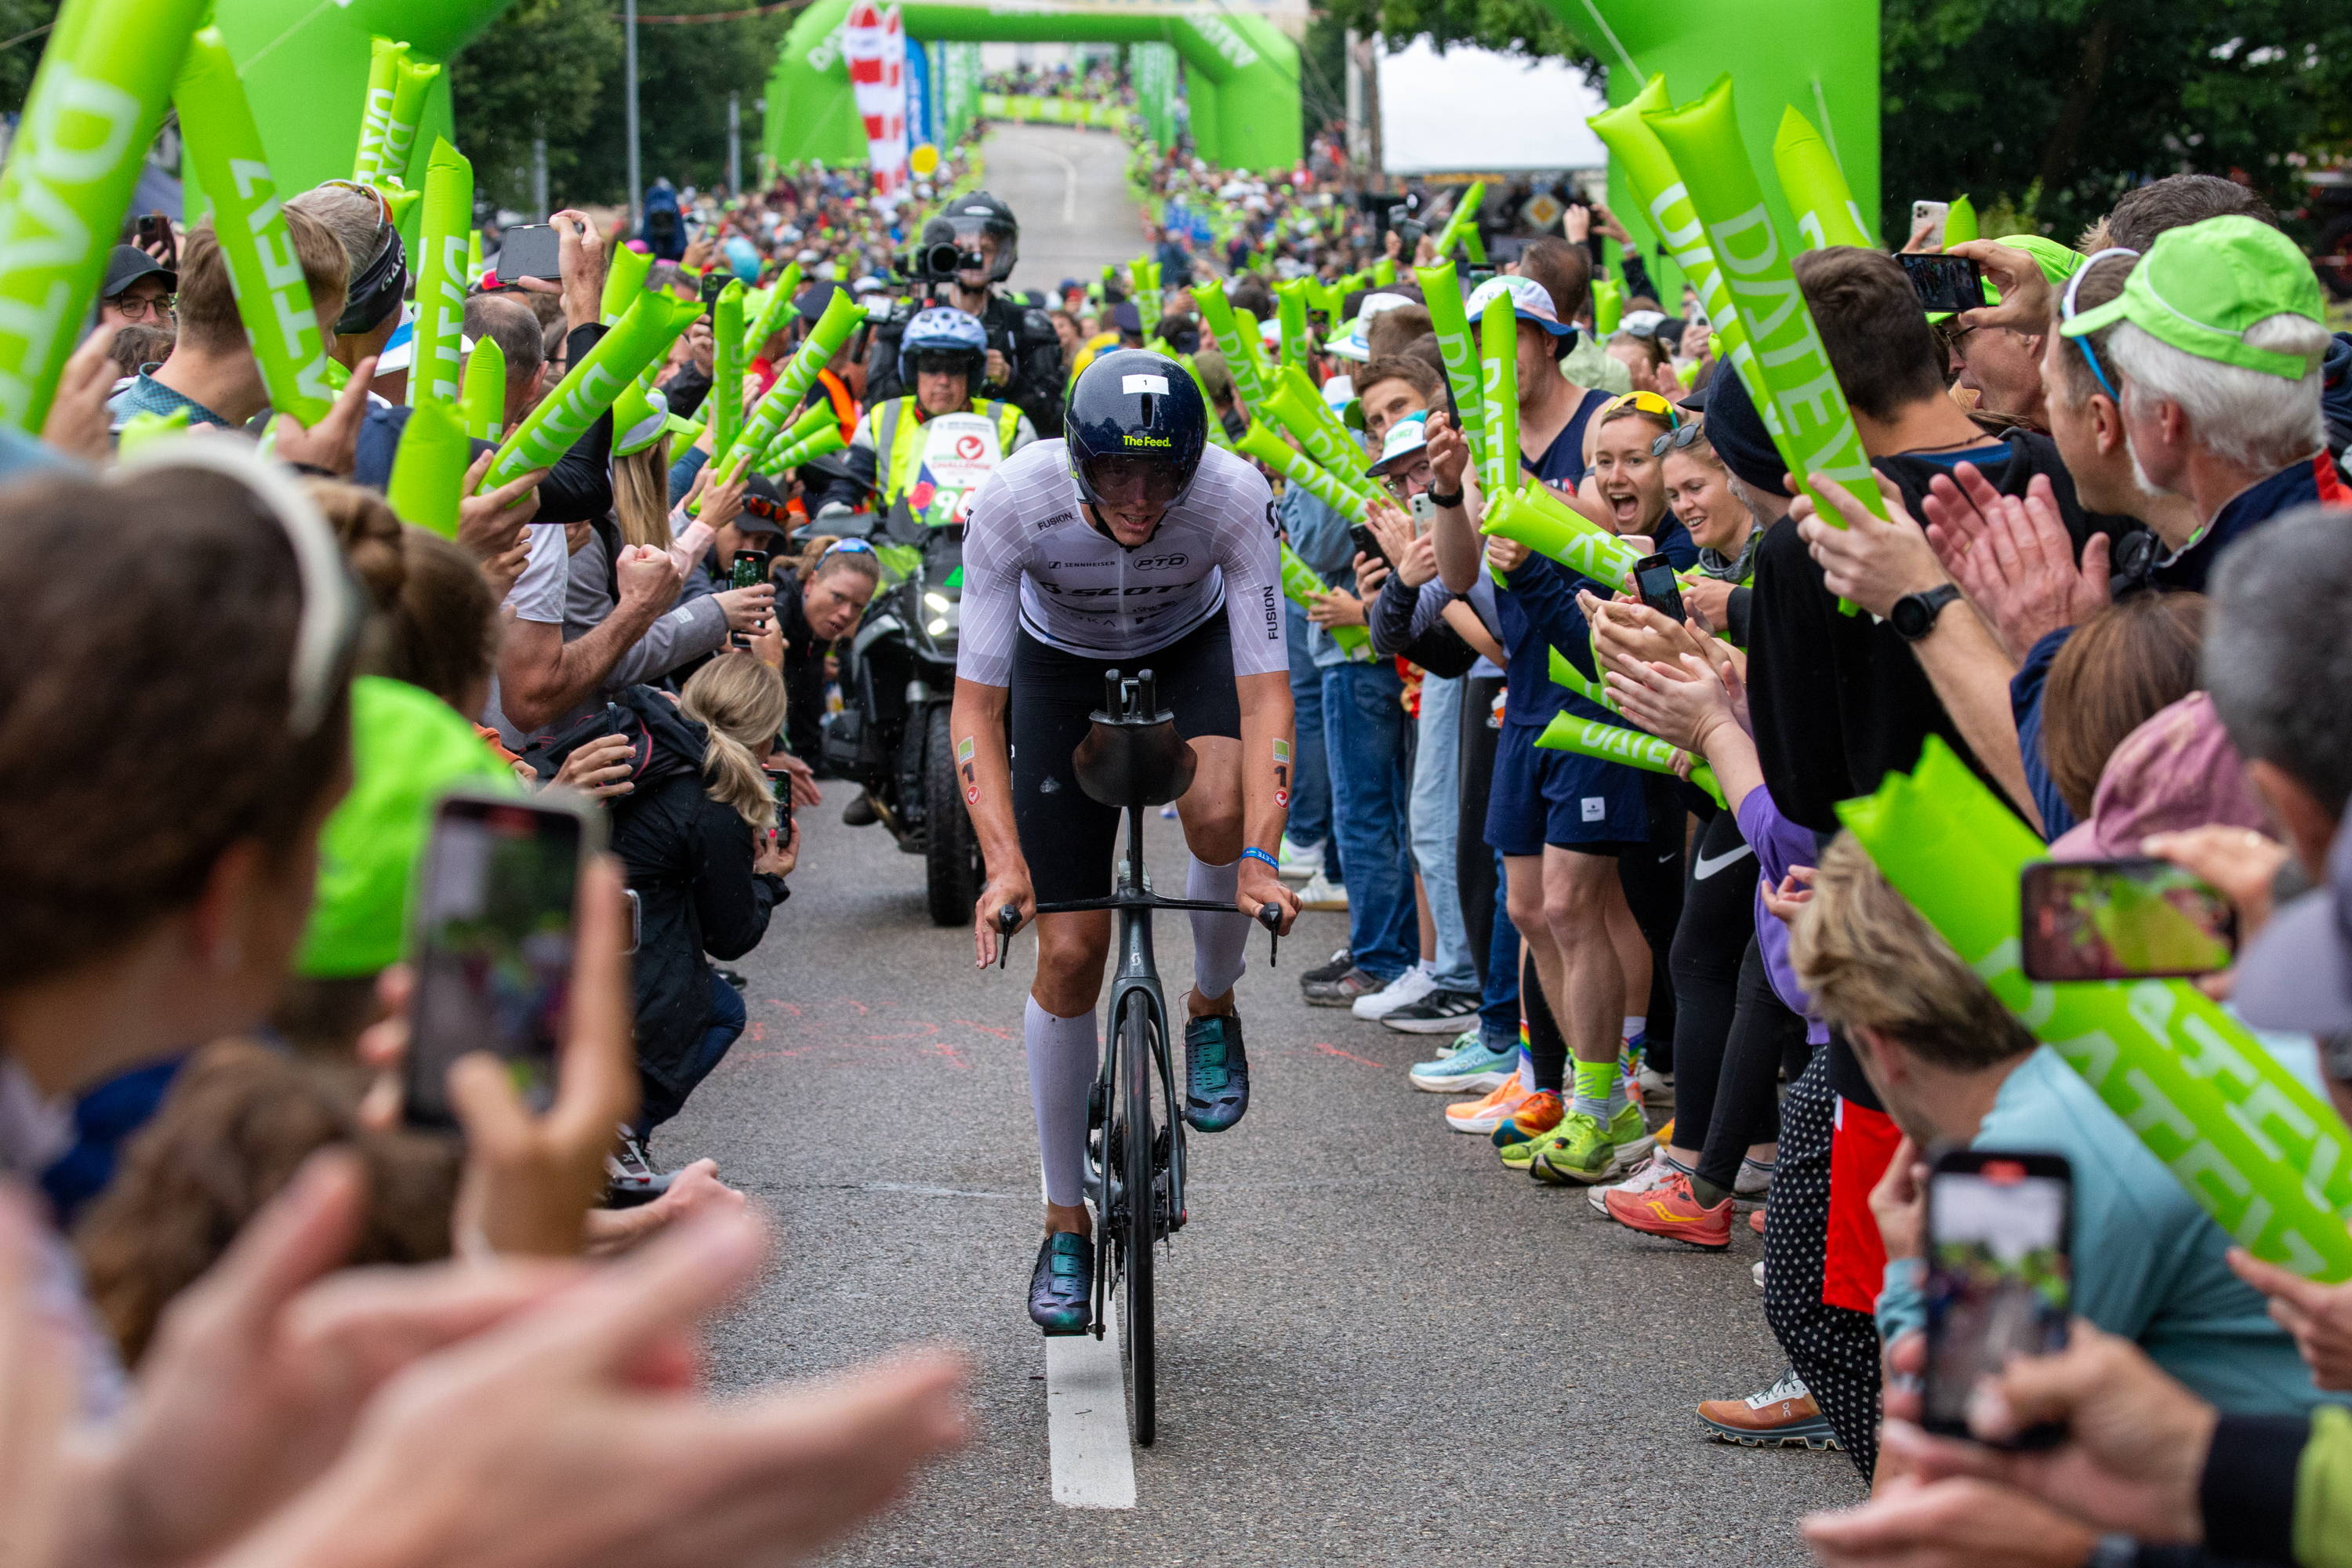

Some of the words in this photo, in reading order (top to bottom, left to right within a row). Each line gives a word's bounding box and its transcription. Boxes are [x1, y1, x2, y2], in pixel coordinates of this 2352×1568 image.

[230, 159, 334, 404] ATEV
[1710, 201, 1874, 482] DATEV
[1123, 435, 1143, 447] The
[1144, 436, 1172, 448] Feed.
[1482, 357, 1505, 494] DATE
[1304, 428, 1385, 503] DATE
[1037, 512, 1073, 531] FUSION
[1137, 556, 1186, 568] PTO
[1263, 585, 1279, 641] FUSION
[1581, 721, 1679, 765] DATE
[961, 762, 975, 784] 1
[1274, 765, 1287, 787] 1
